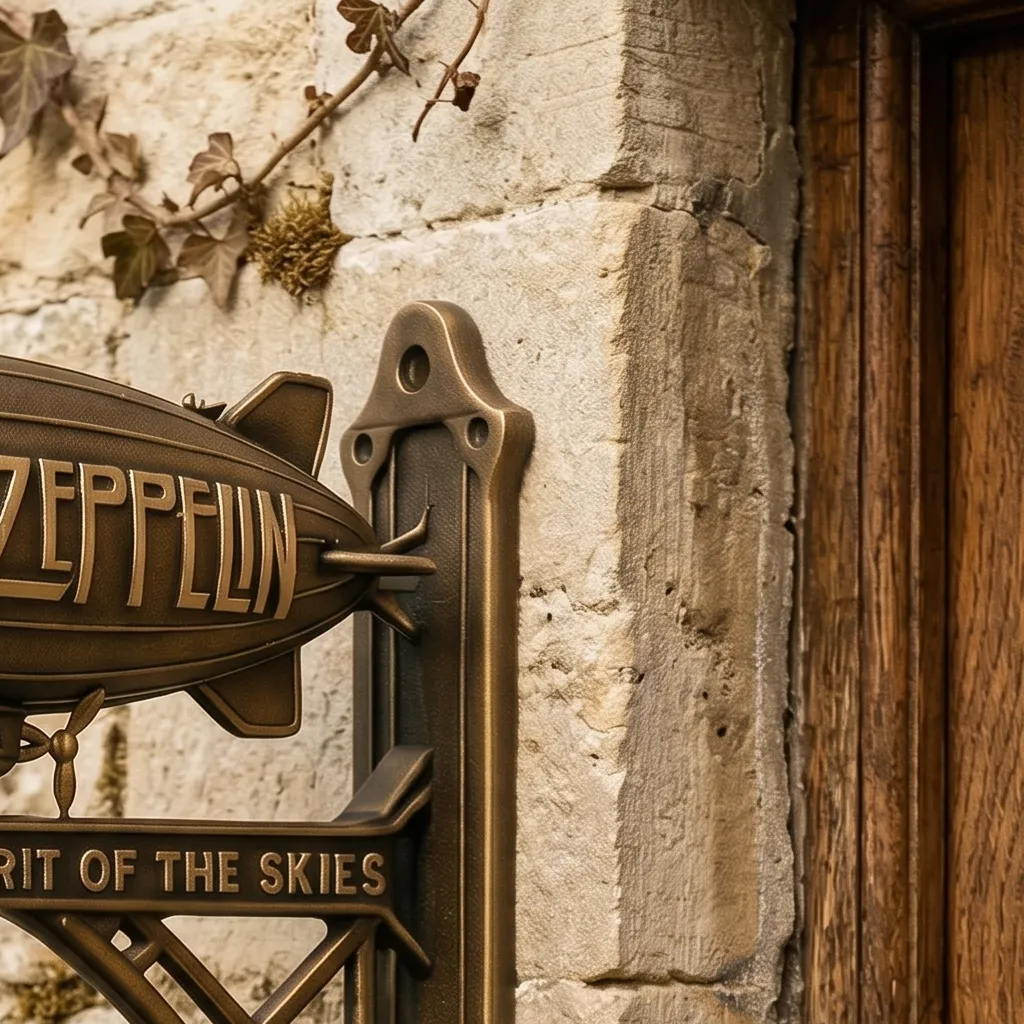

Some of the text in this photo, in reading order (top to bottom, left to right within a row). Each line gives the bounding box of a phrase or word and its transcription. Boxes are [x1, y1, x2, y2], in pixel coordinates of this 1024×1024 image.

[78, 848, 138, 893] OF
[154, 850, 241, 894] THE
[259, 851, 387, 896] SKIES
